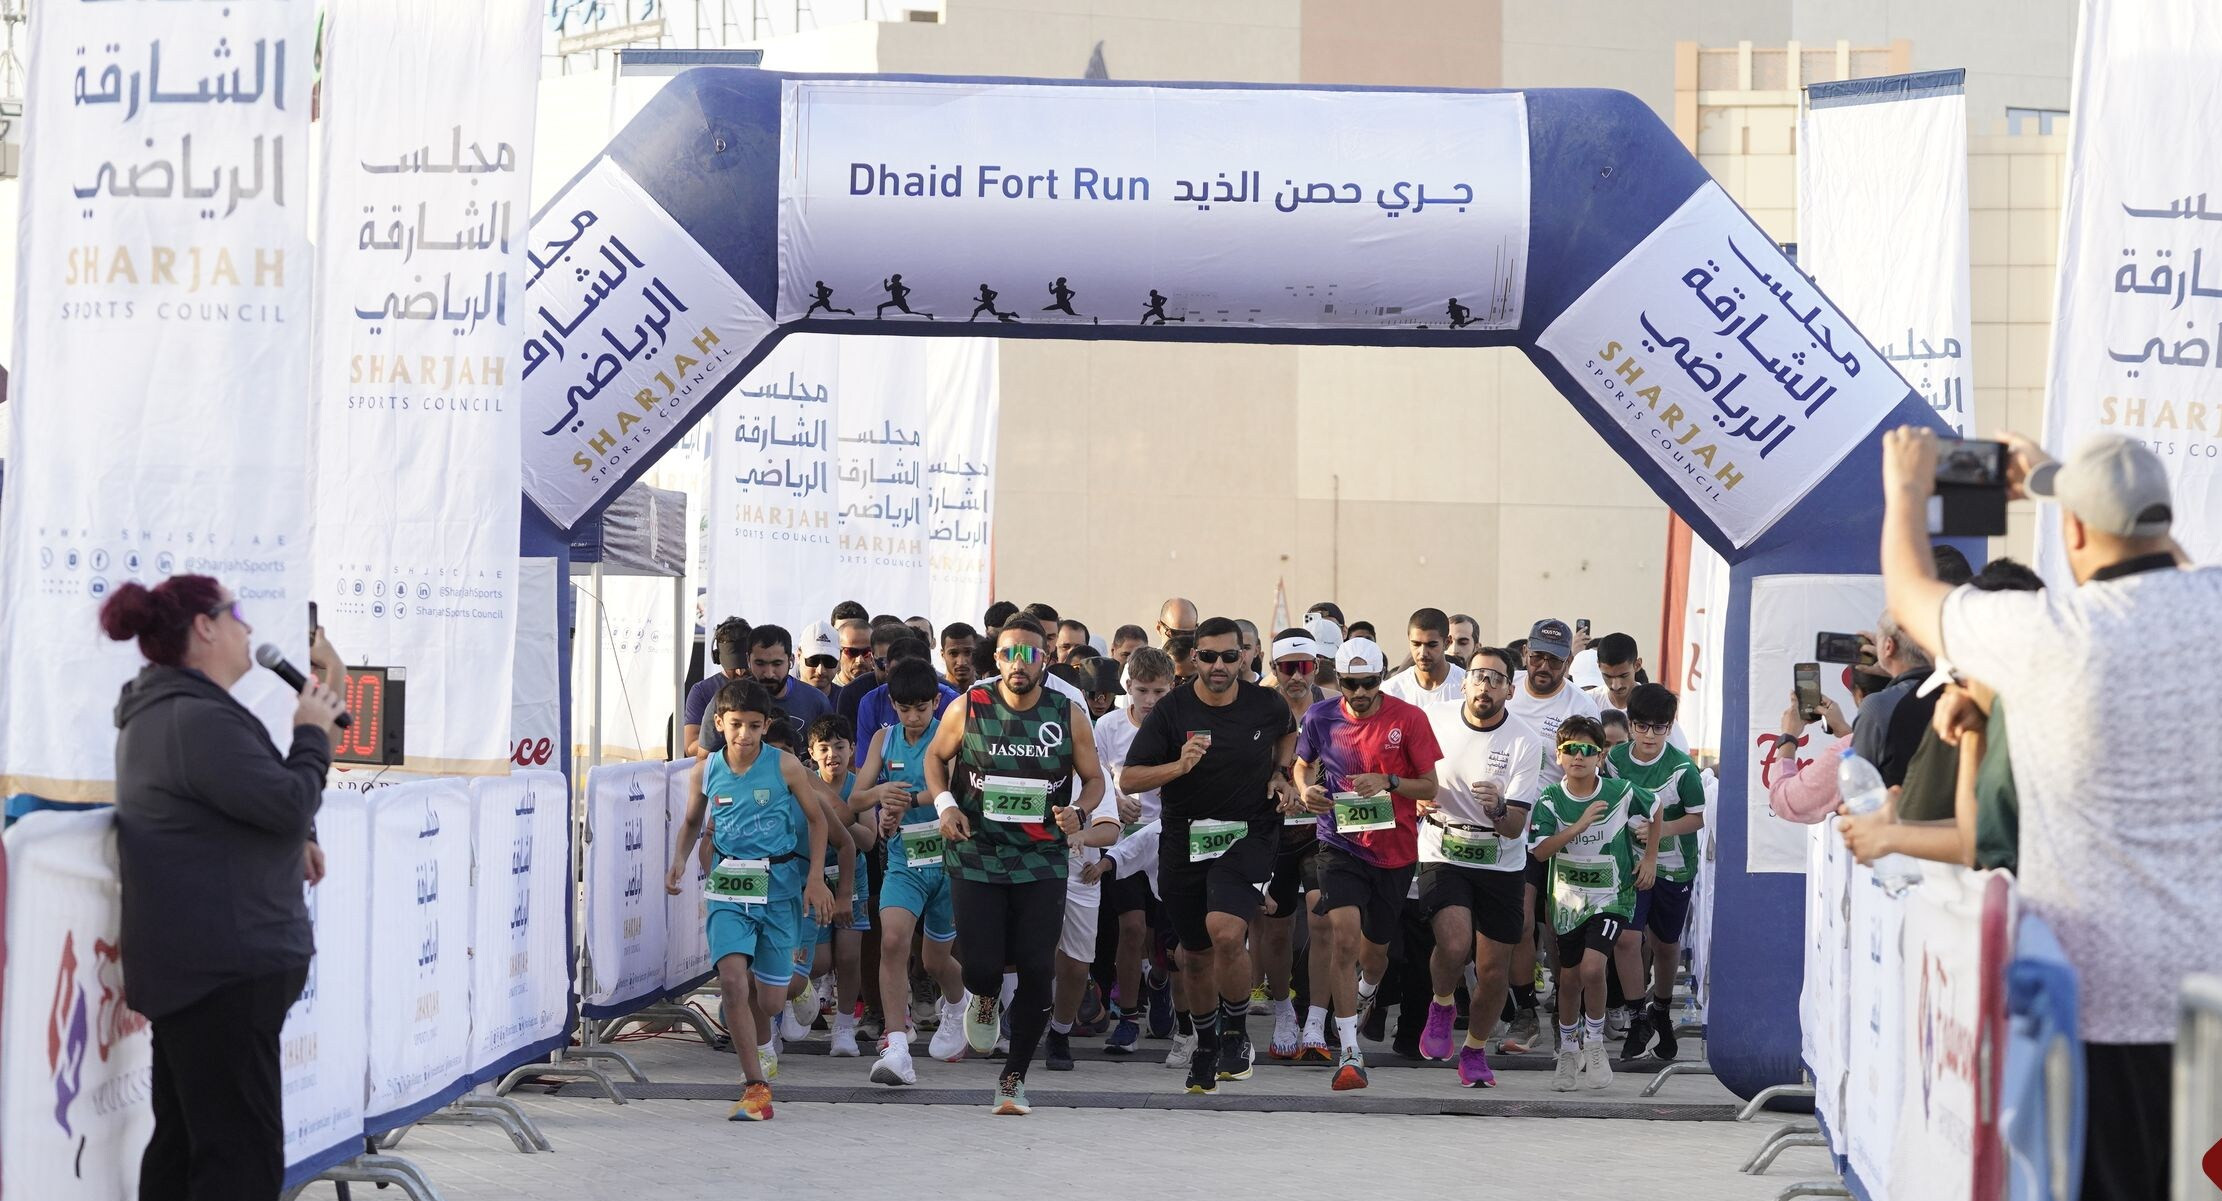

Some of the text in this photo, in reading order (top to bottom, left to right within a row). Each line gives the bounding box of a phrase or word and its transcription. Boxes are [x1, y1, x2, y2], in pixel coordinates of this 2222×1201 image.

[74, 37, 286, 123] الشارقة
[360, 124, 516, 186] مجلس
[73, 133, 286, 219] الرياضي
[849, 162, 1150, 202] Dhaid Fort Run
[1174, 171, 1474, 217] جري حصن الذيد
[358, 200, 511, 264] الشارقة
[65, 245, 285, 293] SHARJAH
[61, 301, 286, 323] SPORTS COUNCIL
[354, 271, 507, 336] الرياضي
[1727, 234, 1861, 378] مجلس
[542, 277, 688, 436] الرياضي
[1681, 259, 1838, 419] الشارقة
[351, 354, 506, 391] SHARJAH
[739, 371, 829, 409] مجلس
[1640, 310, 1796, 460] الرياضي
[349, 396, 504, 413] SPORTS COUNCIL
[573, 326, 721, 473] SHARJAH
[591, 425, 651, 484] SPORTS
[659, 347, 732, 418] COUNCIL
[1599, 341, 1745, 491] SHARJAH
[735, 414, 828, 452] الشارقة
[838, 419, 920, 451] مجلس
[1585, 360, 1720, 502] SPORTS COUNCIL
[735, 458, 828, 498] الرياضي
[735, 503, 830, 529] SHARJAH
[772, 531, 831, 545] COUNCIL
[839, 534, 922, 555] HARJAH
[875, 557, 923, 568] COUNCIL
[472, 608, 503, 620] Council
[988, 743, 1049, 758] JASSEM
[985, 795, 1032, 813] 3 275
[1348, 806, 1378, 821] 201
[907, 848, 916, 860] 3
[1191, 833, 1235, 855] 3 300
[1453, 845, 1485, 860] 259
[706, 877, 754, 892] 3 206
[1568, 869, 1600, 883] 282
[1602, 918, 1618, 940] 11
